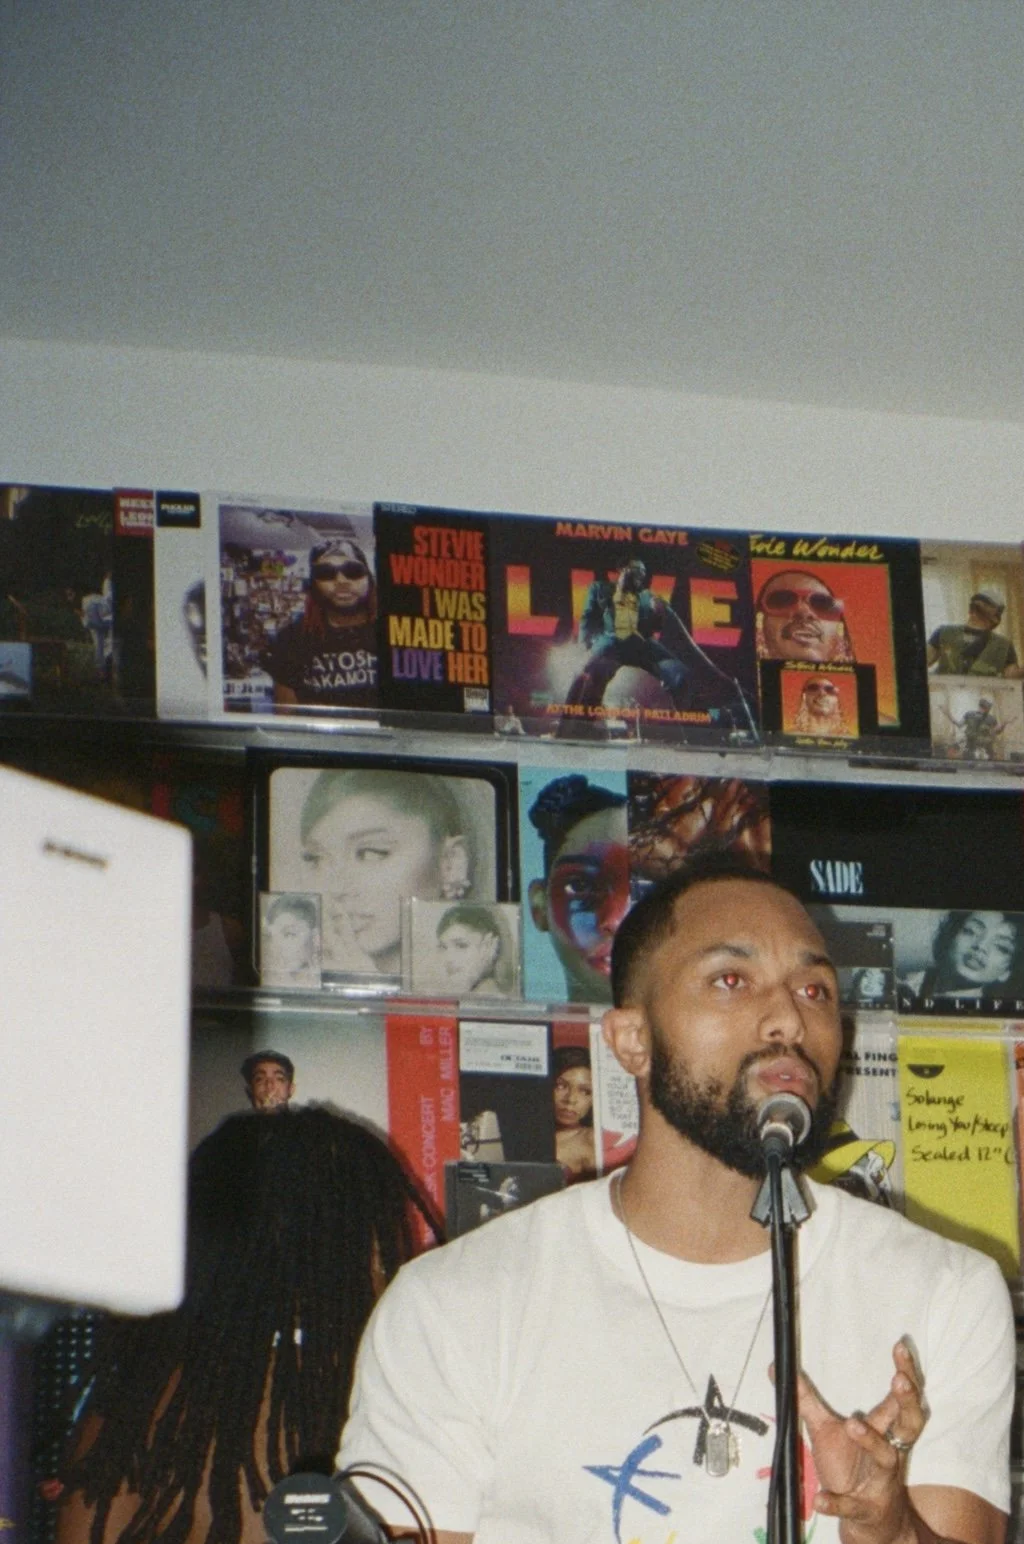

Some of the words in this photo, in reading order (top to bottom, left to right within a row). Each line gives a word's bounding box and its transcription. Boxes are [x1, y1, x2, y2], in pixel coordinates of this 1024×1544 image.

[413, 526, 485, 560] STEVIE
[555, 521, 632, 541] MARVIN
[637, 527, 689, 546] GAYE
[389, 554, 486, 591] WONDER
[421, 587, 431, 616] I
[434, 589, 486, 621] WAS
[388, 615, 455, 650] MADE
[460, 623, 488, 651] TO
[392, 649, 444, 681] LOVE
[447, 652, 489, 685] HER
[563, 704, 585, 717] THE
[810, 859, 863, 895] SADE
[420, 1026, 433, 1045] BY
[439, 1026, 454, 1081] MILLER
[440, 1088, 456, 1123] MAC
[905, 1087, 966, 1114] Solange
[420, 1094, 437, 1168] CONCERT
[908, 1116, 948, 1140] Losing
[911, 1146, 971, 1163] Sealed
